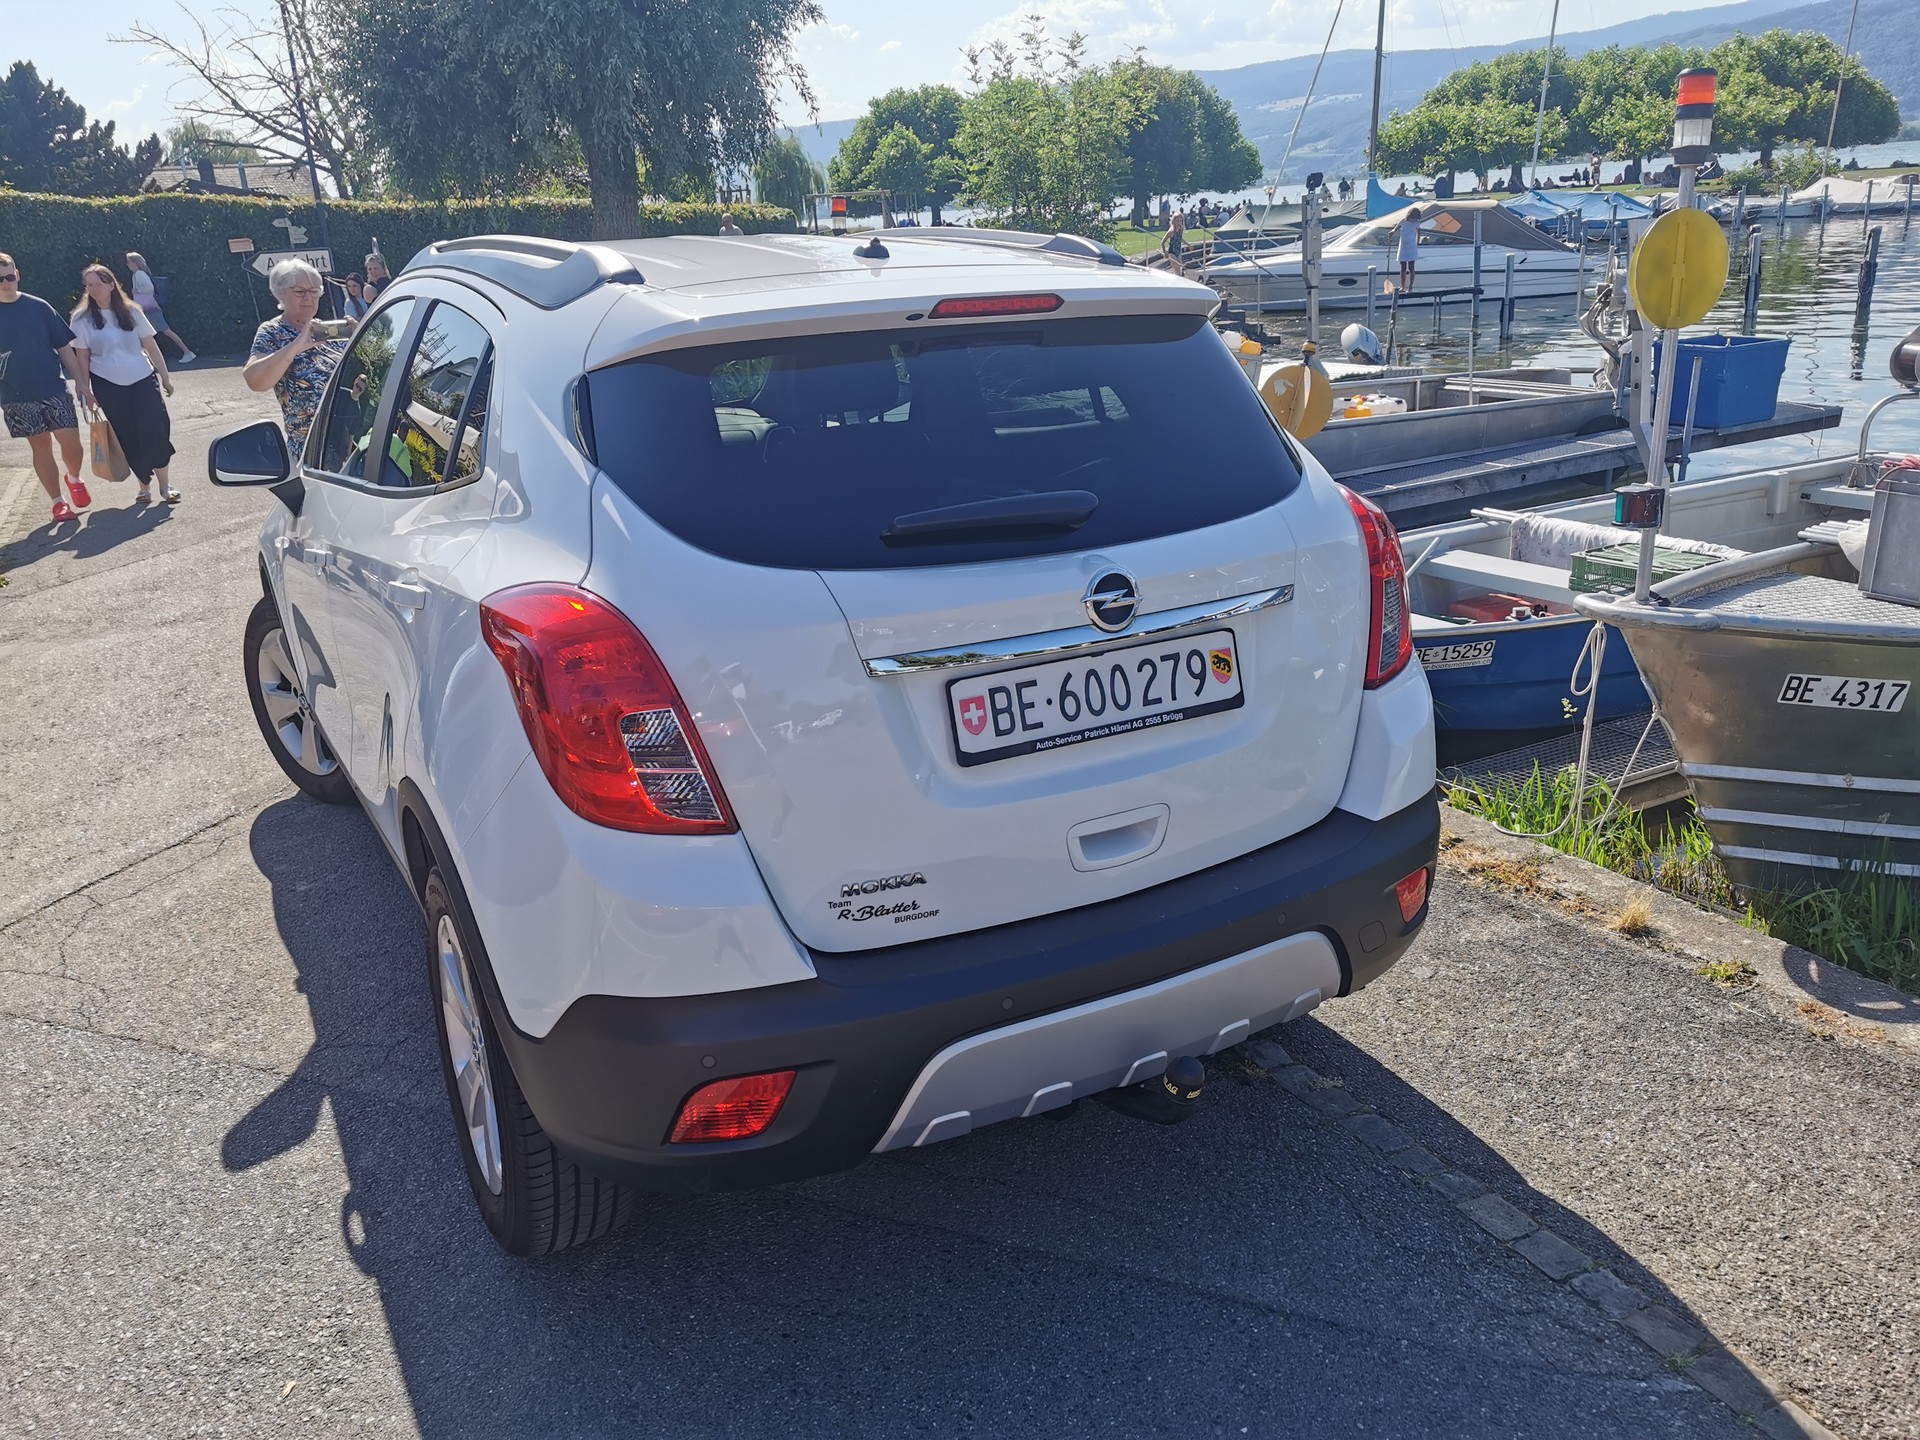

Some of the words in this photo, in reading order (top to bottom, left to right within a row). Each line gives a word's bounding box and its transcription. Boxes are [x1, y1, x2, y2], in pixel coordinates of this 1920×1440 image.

[267, 254, 327, 271] Ahrt
[1441, 641, 1494, 660] 15259
[1780, 676, 1822, 703] BE
[1831, 680, 1908, 709] 4317
[1036, 735, 1082, 750] Auto-Service
[1085, 727, 1109, 738] Patrick
[1111, 722, 1131, 733] Hänni
[1132, 720, 1143, 728] AG
[1162, 712, 1183, 722] Brügg
[840, 872, 927, 898] MOKKA
[827, 900, 852, 909] Team
[894, 909, 940, 924] BURGDORF
